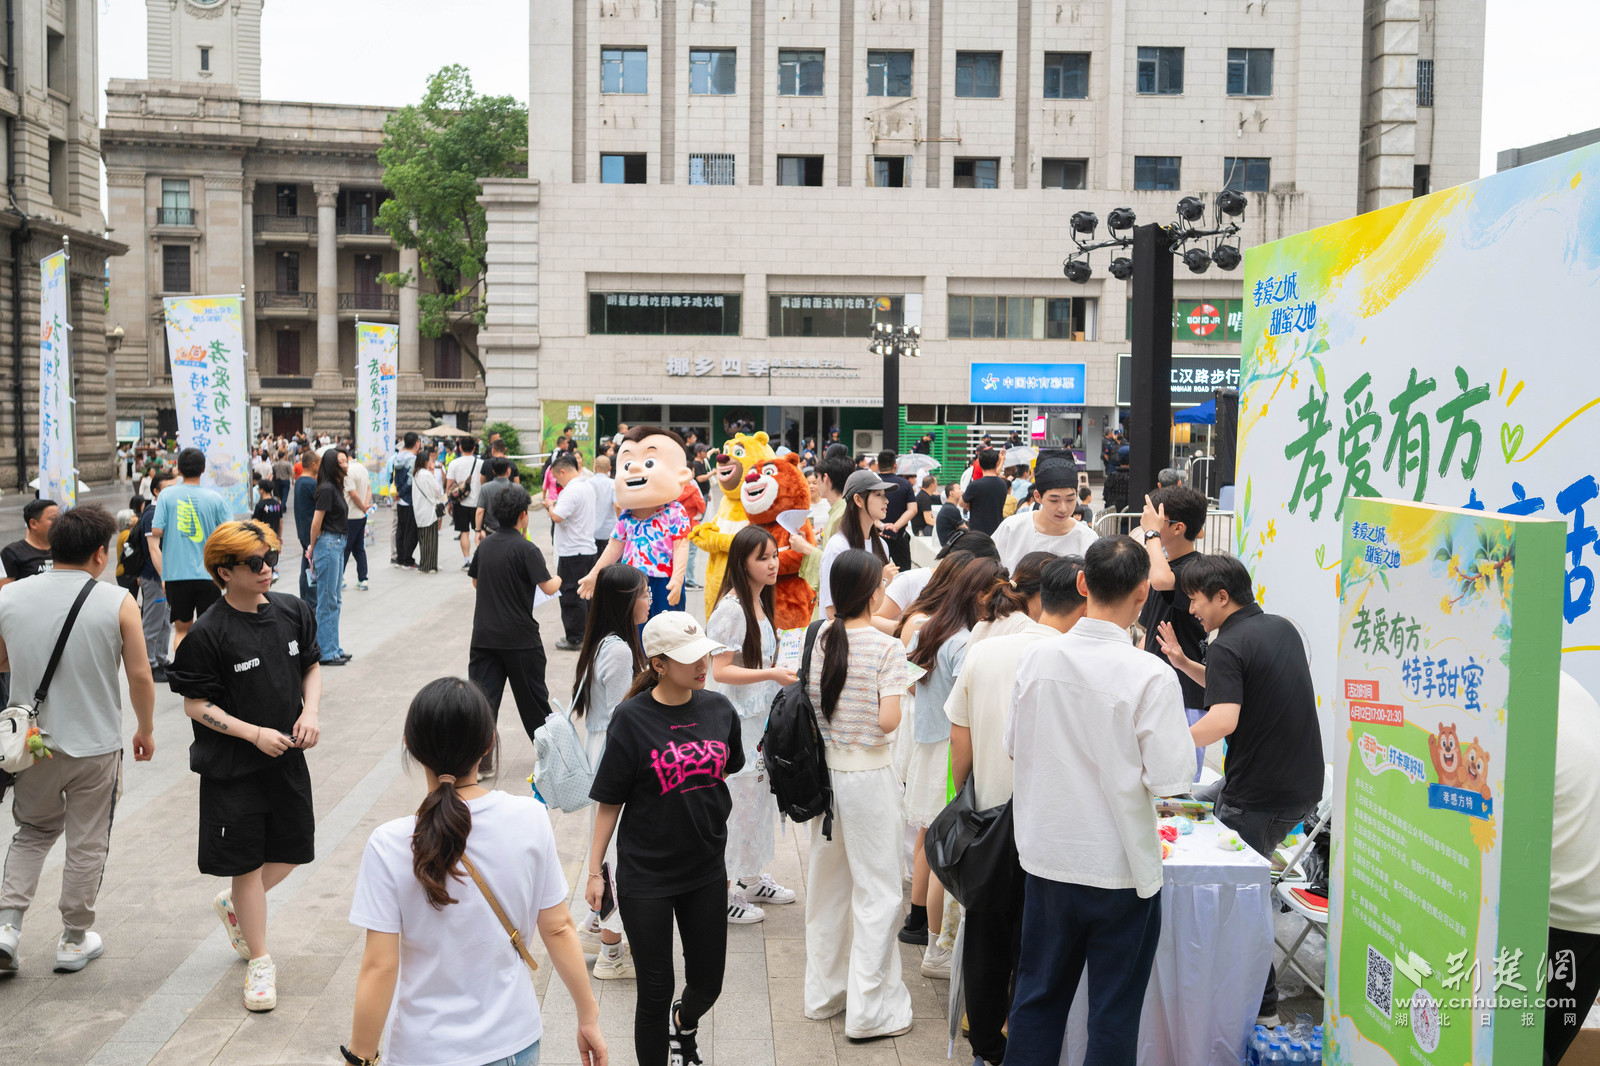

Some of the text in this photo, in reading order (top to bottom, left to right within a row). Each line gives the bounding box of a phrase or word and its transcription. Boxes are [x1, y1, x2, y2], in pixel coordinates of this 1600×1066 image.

[607, 295, 724, 307] 明星都爱吃的椰子鸡火锅
[1253, 271, 1300, 308] 孝爱之城
[1269, 301, 1317, 336] 甜蜜之地
[666, 357, 769, 377] 椰乡四季
[368, 358, 381, 432] 孝爱有方
[1002, 376, 1074, 389] 中国体育彩票
[1285, 366, 1491, 522] 孝爱有方
[1351, 520, 1387, 546] 孝爱之城
[1364, 545, 1401, 569] 甜蜜之地
[1352, 605, 1422, 659] 孝爱有方
[234, 657, 260, 672] UNDFTD
[1347, 683, 1373, 699] 活动时间
[1402, 656, 1484, 713] 特享甜蜜
[1443, 791, 1473, 810] 孝感方特
